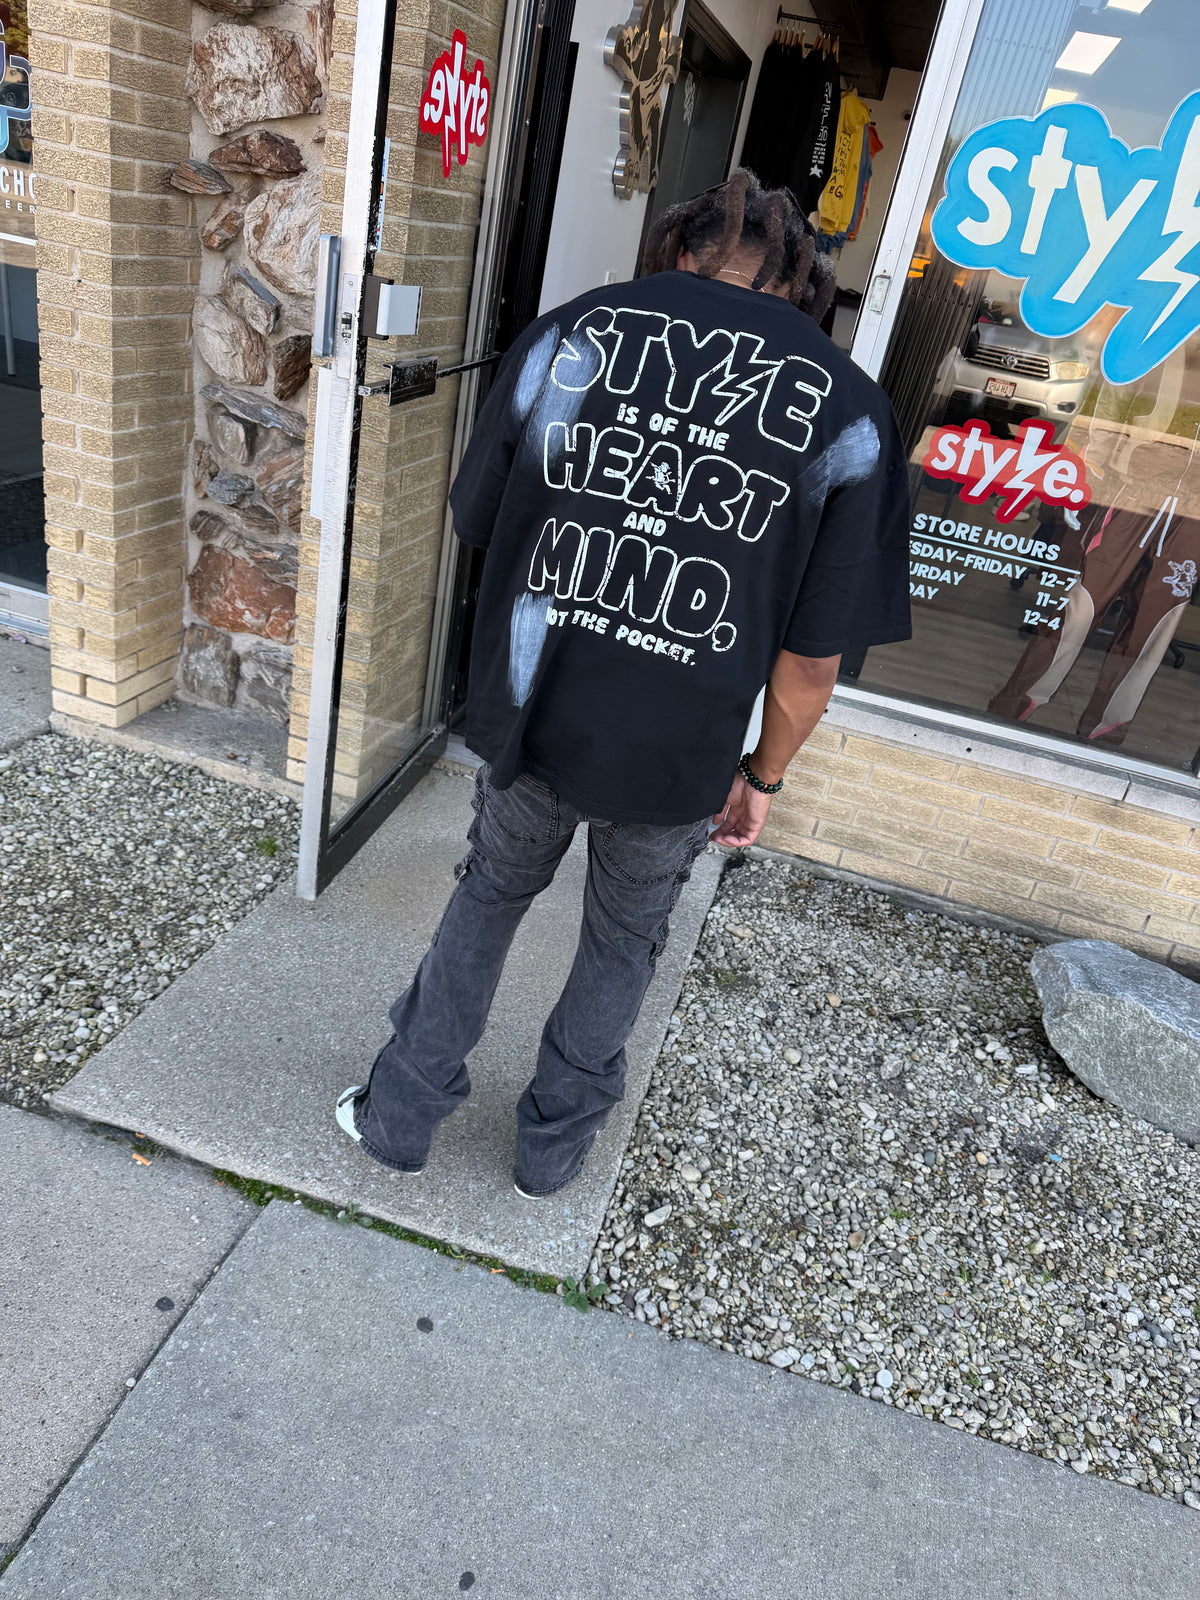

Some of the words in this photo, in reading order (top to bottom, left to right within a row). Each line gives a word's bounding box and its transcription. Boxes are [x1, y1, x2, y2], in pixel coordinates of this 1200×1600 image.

[551, 306, 833, 453] STYLE
[649, 412, 679, 436] OF
[687, 424, 730, 452] THE
[543, 421, 791, 542] HEART
[622, 511, 667, 537] AND
[913, 513, 983, 544] STORE
[984, 529, 1062, 562] HOURS
[1035, 591, 1070, 611] 11-7
[1039, 571, 1078, 592] 12-7
[571, 609, 611, 635] THE
[615, 624, 696, 666] POCKET.
[1023, 609, 1061, 631] 12-4
